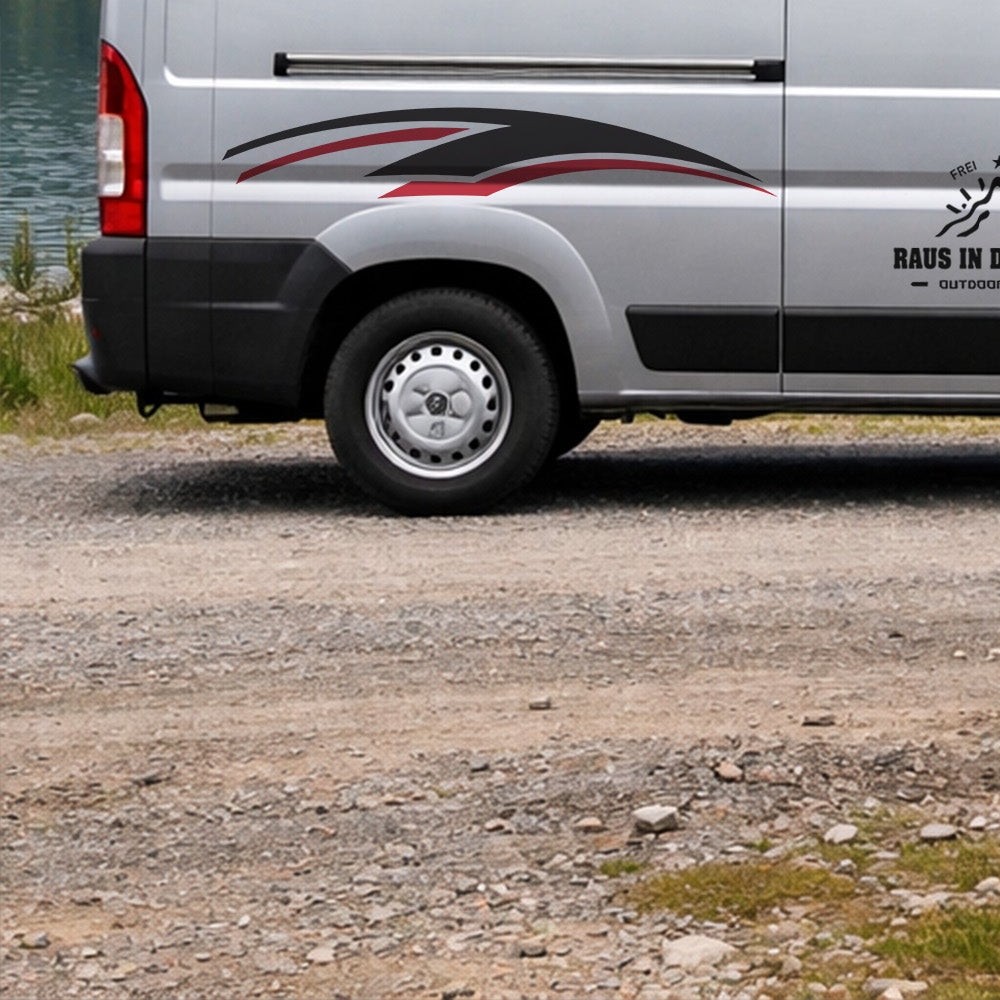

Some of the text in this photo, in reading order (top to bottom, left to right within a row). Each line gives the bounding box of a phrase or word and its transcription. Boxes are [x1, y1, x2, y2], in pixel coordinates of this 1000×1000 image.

[949, 160, 978, 180] FREI
[893, 247, 951, 269] RAUS
[959, 247, 982, 269] IN
